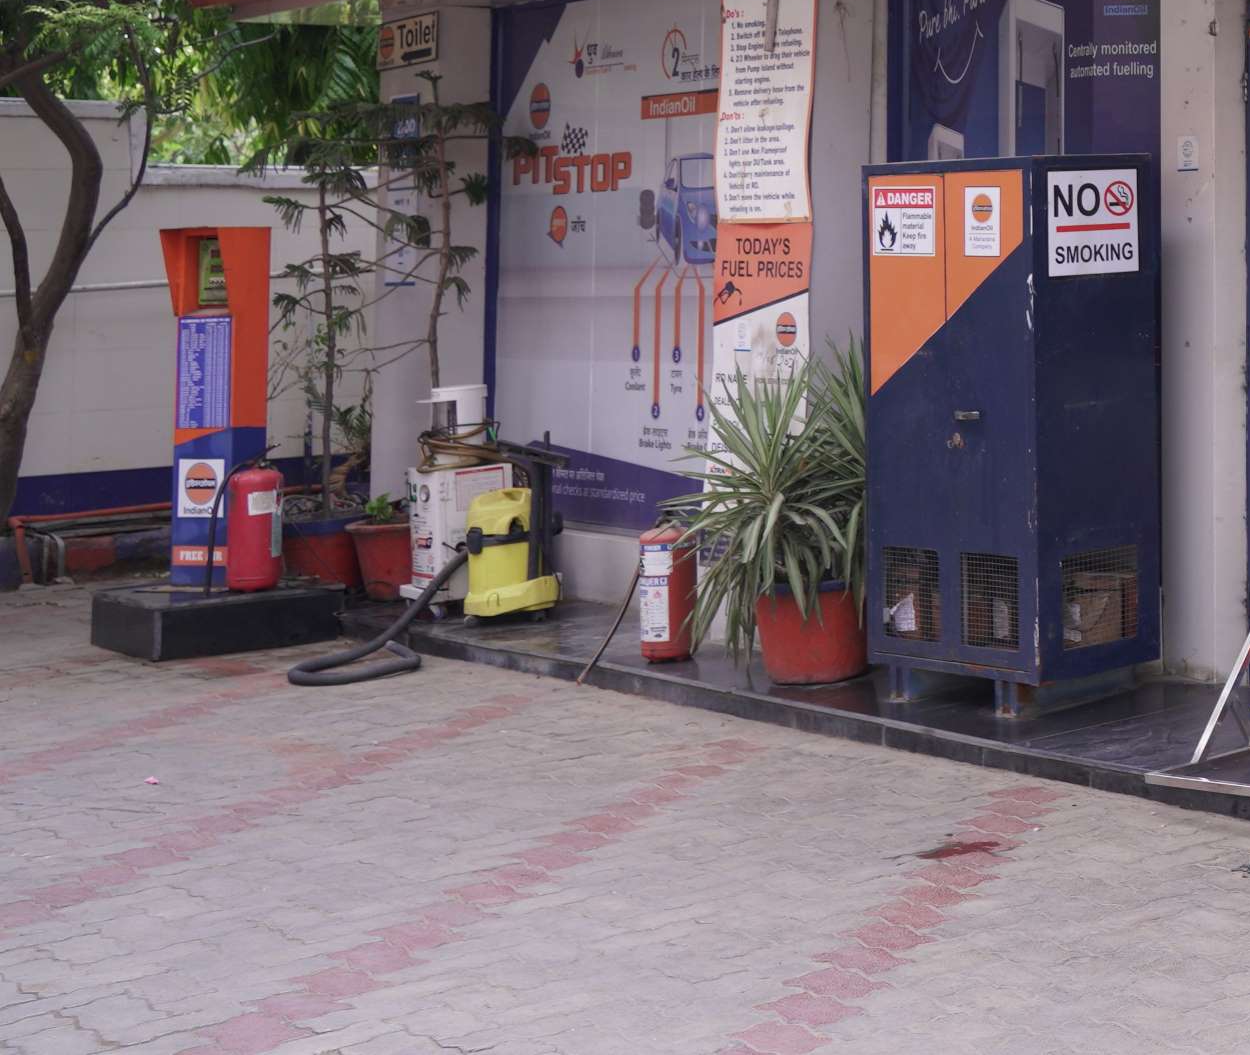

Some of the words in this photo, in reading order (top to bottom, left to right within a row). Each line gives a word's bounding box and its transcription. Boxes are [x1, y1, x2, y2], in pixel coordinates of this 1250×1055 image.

[397, 19, 436, 49] Toilet
[1068, 42, 1098, 59] Centrally
[1101, 40, 1157, 55] monitored
[1070, 62, 1110, 78] automated
[1113, 61, 1154, 79] fuelling
[649, 97, 695, 115] IndianOil
[552, 151, 632, 195] STOP
[888, 192, 933, 206] DANGER
[1053, 183, 1100, 217] NO
[736, 238, 791, 255] TODAY'S
[1055, 242, 1134, 264] SMOKING
[721, 260, 752, 277] FUEL
[757, 261, 804, 279] PRICES
[180, 550, 204, 561] FREE
